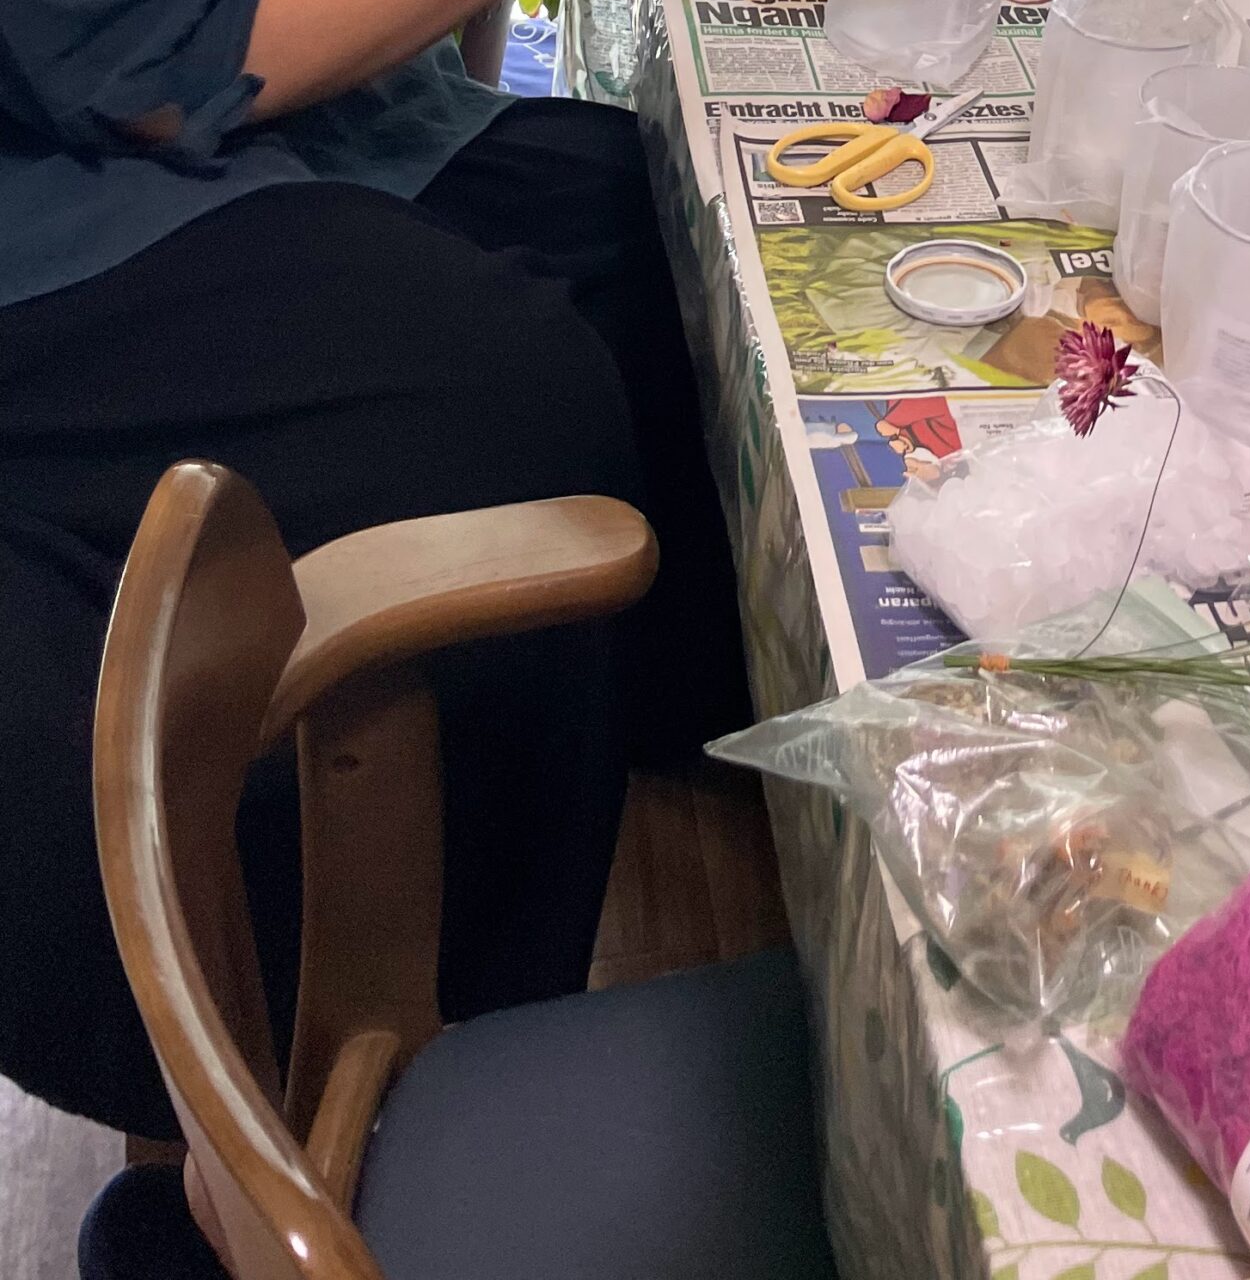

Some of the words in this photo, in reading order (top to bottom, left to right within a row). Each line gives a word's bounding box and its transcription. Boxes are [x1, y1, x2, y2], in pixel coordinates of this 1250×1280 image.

[703, 26, 745, 35] Hertha
[747, 27, 788, 36] fordert
[828, 101, 866, 119] hei
